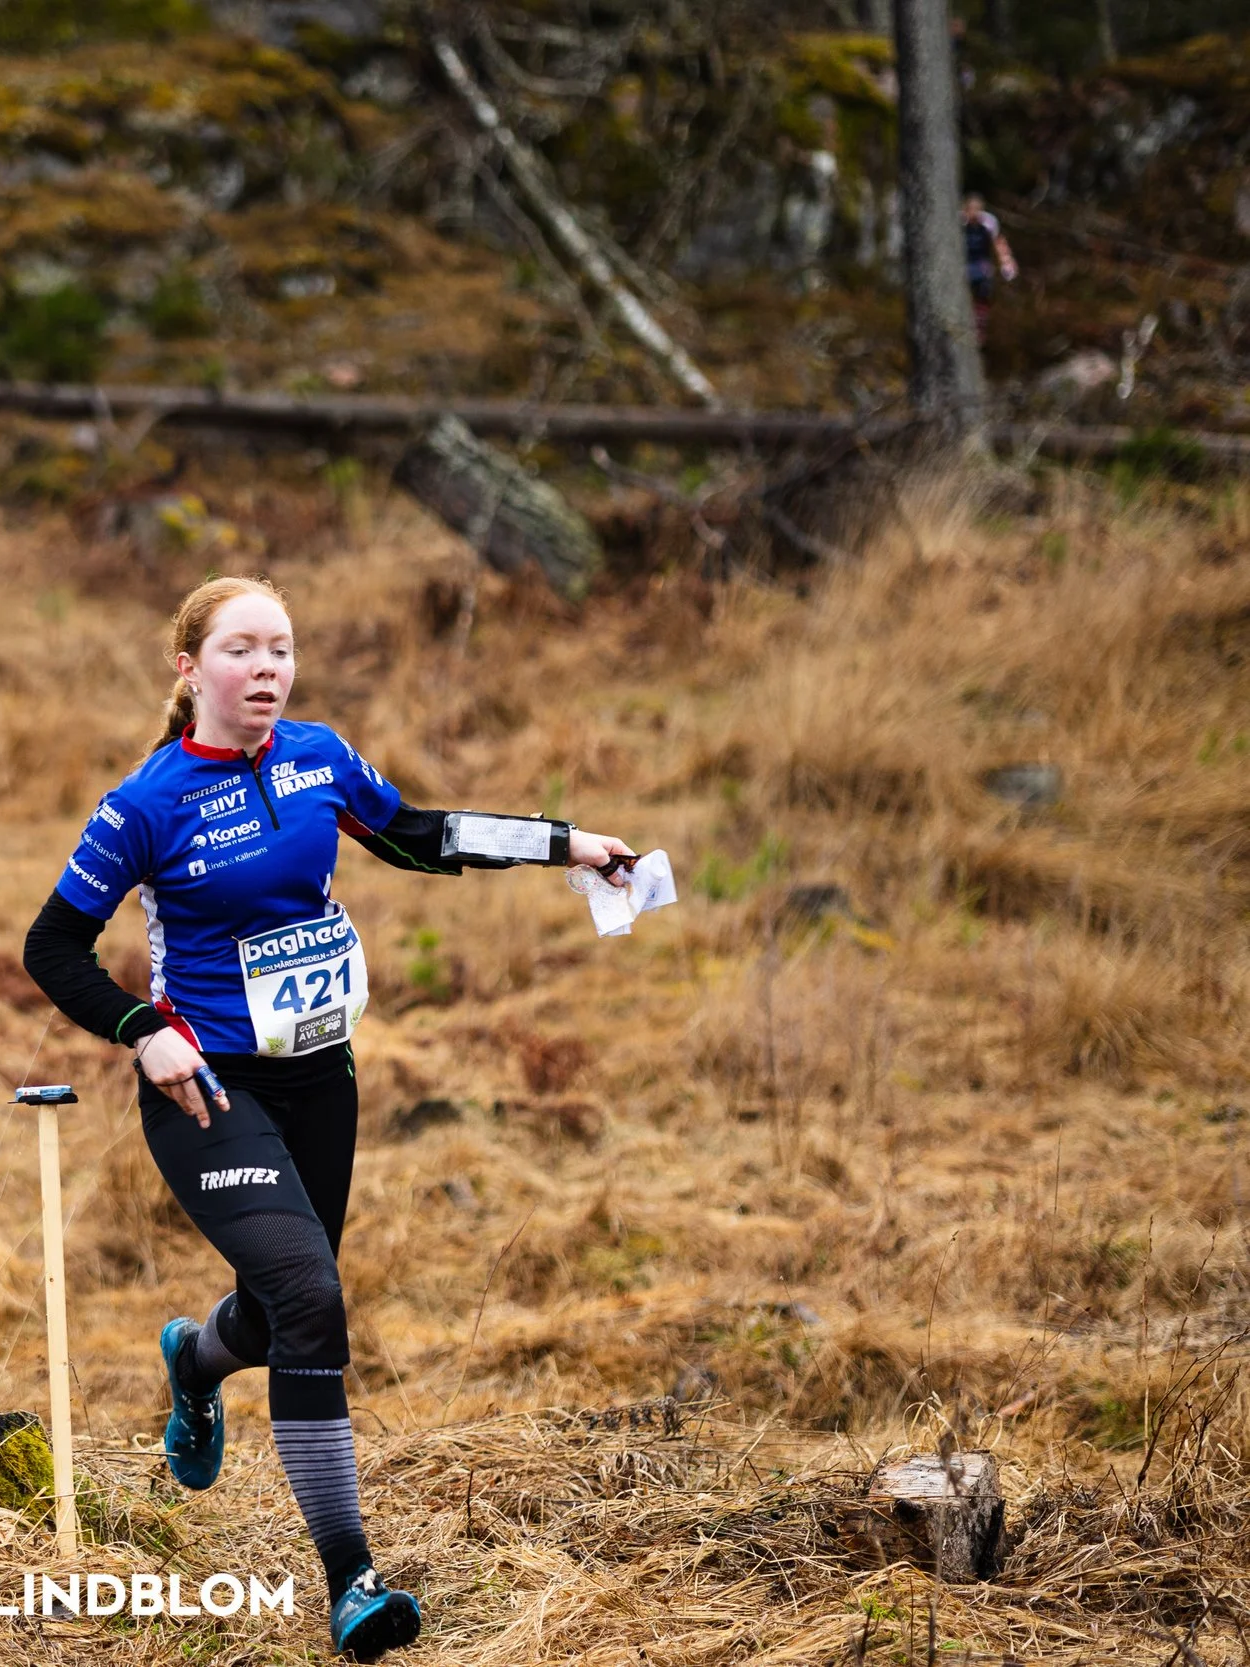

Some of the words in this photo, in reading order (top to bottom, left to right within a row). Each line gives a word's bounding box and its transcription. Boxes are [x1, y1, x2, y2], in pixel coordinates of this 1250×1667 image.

[271, 760, 297, 781] SOL
[182, 775, 241, 803] noname
[218, 788, 247, 812] IVT
[207, 819, 261, 845] Koneo
[93, 840, 124, 866] Handel
[206, 859, 229, 871] Linds
[272, 957, 351, 1014] 421
[299, 1012, 342, 1033] GODKÄNDA
[200, 1167, 280, 1191] TRIMTEX
